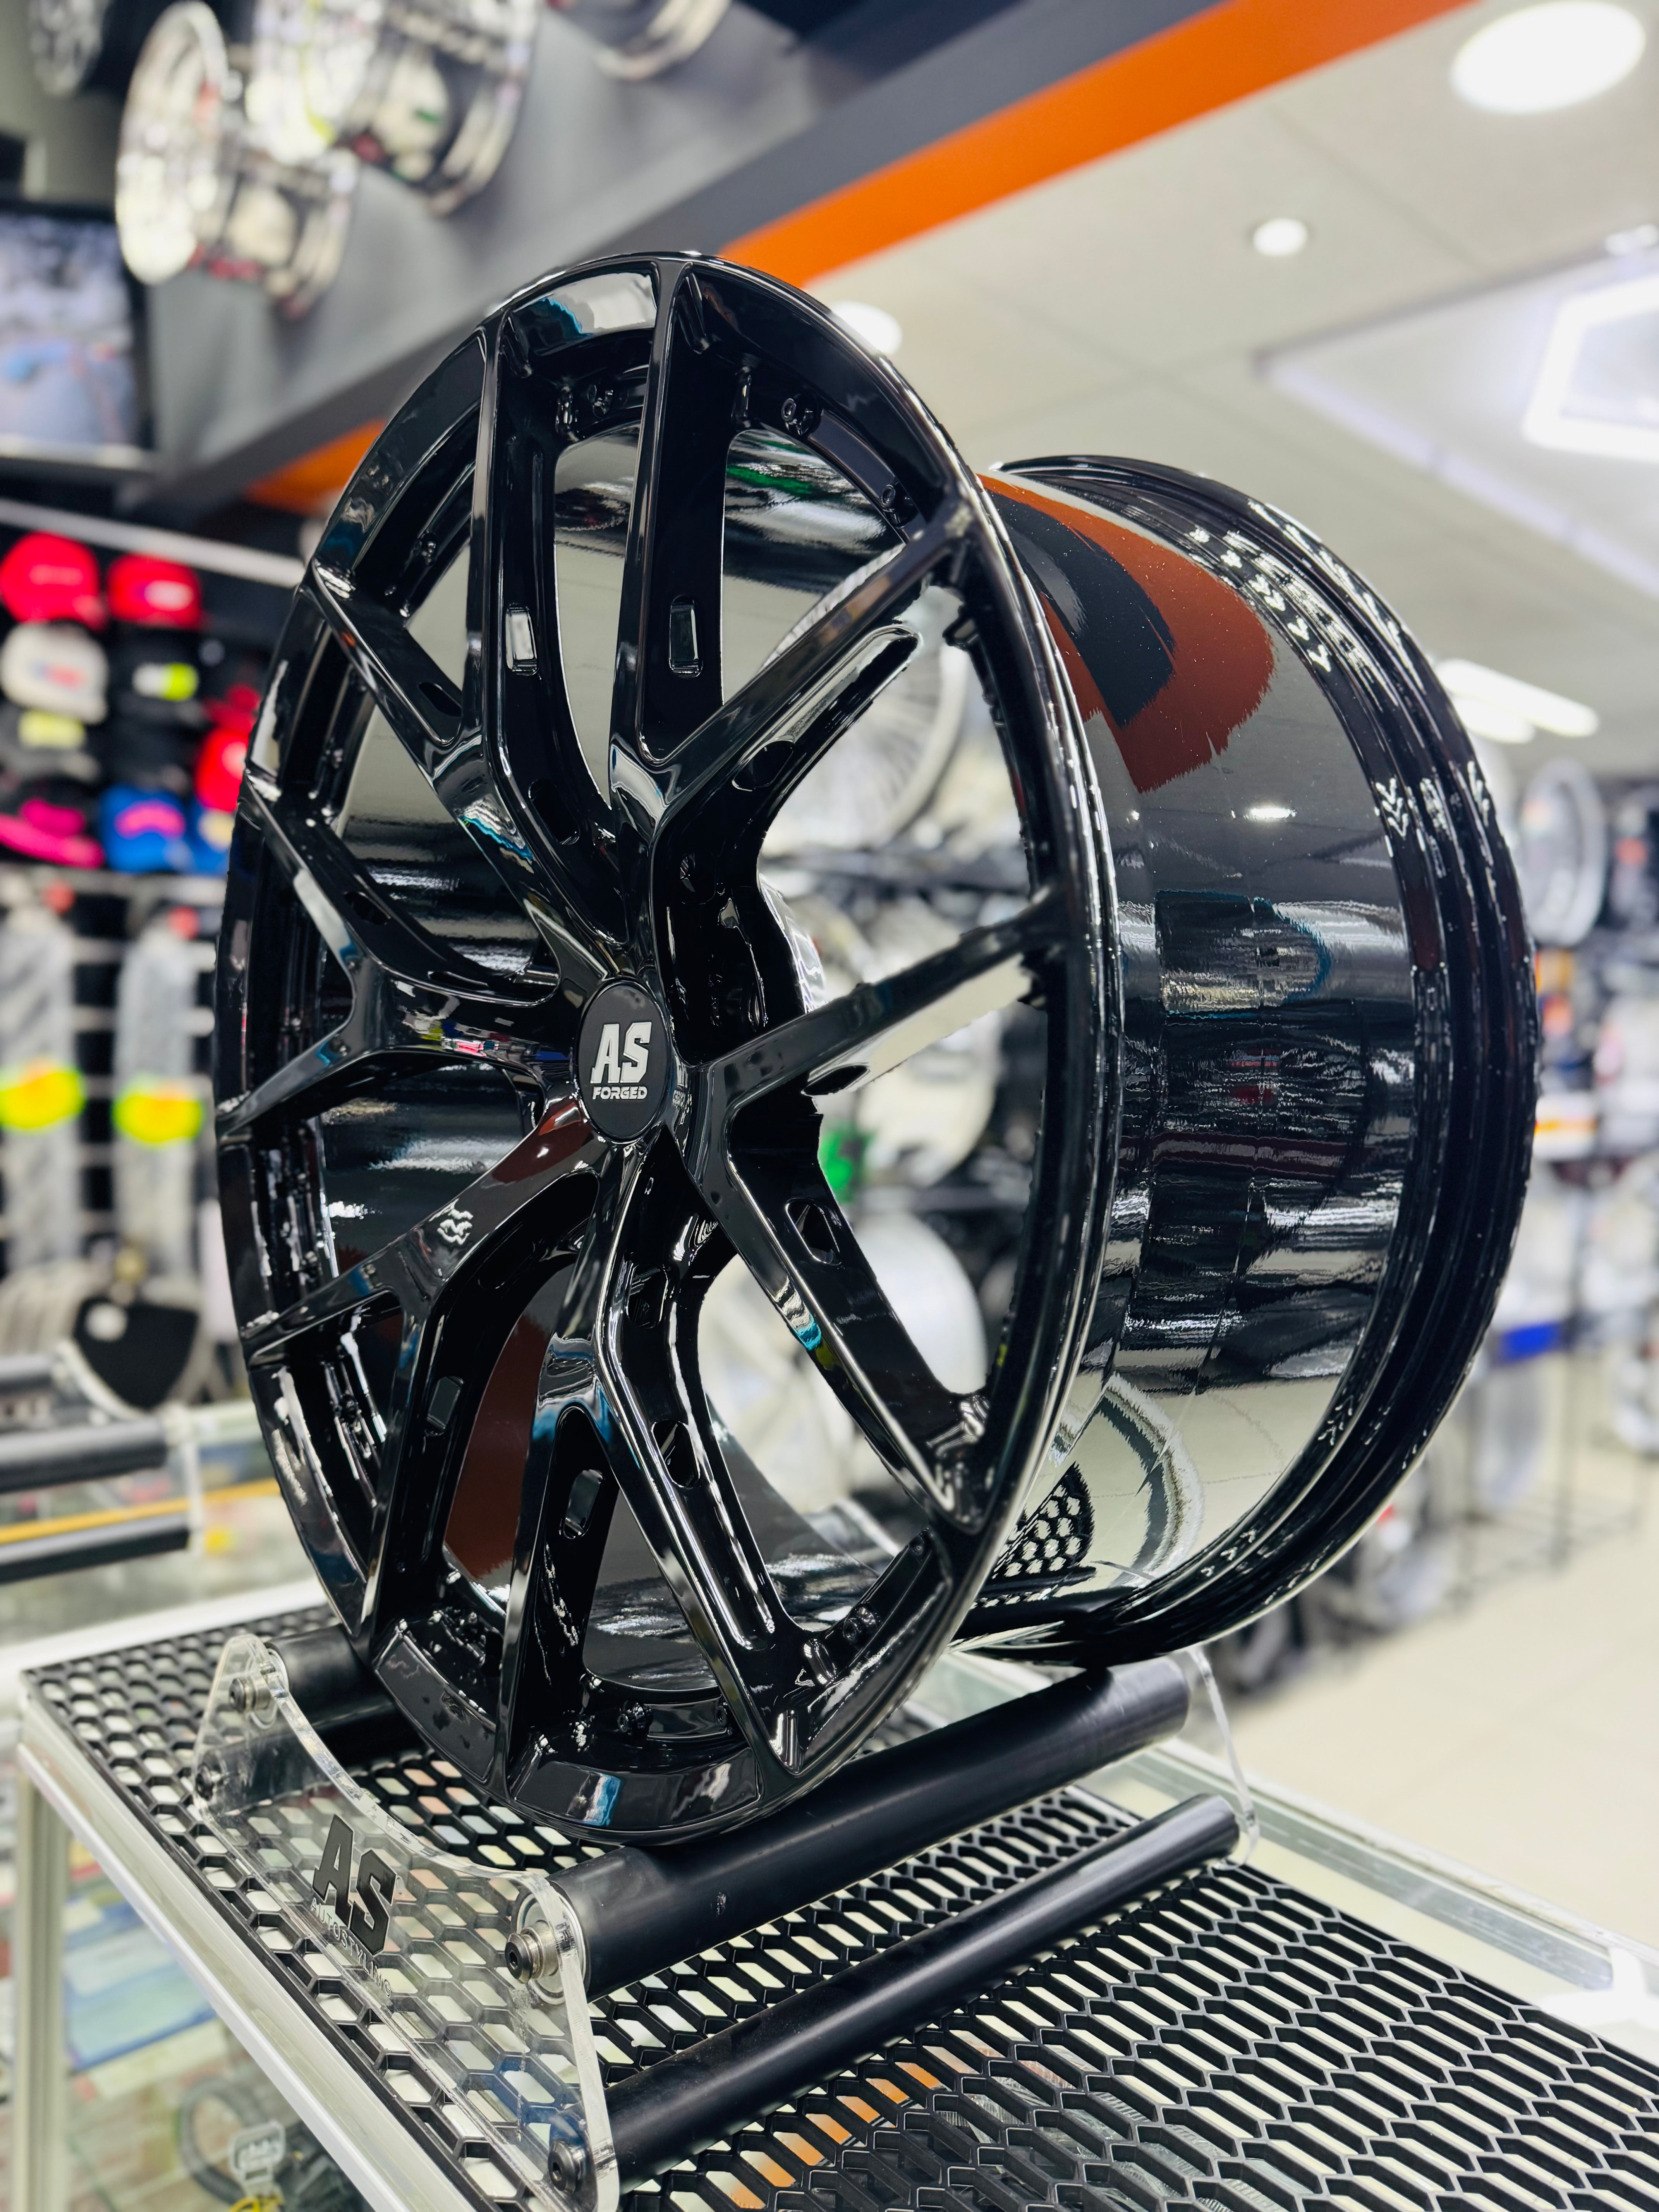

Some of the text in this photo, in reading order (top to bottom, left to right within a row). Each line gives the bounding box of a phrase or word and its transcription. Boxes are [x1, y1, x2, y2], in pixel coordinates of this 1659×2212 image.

[590, 1022, 652, 1083] AS
[592, 1086, 648, 1100] FORGED
[312, 1814, 397, 1957] AS
[311, 1897, 391, 1997] AUTOSTYLING
